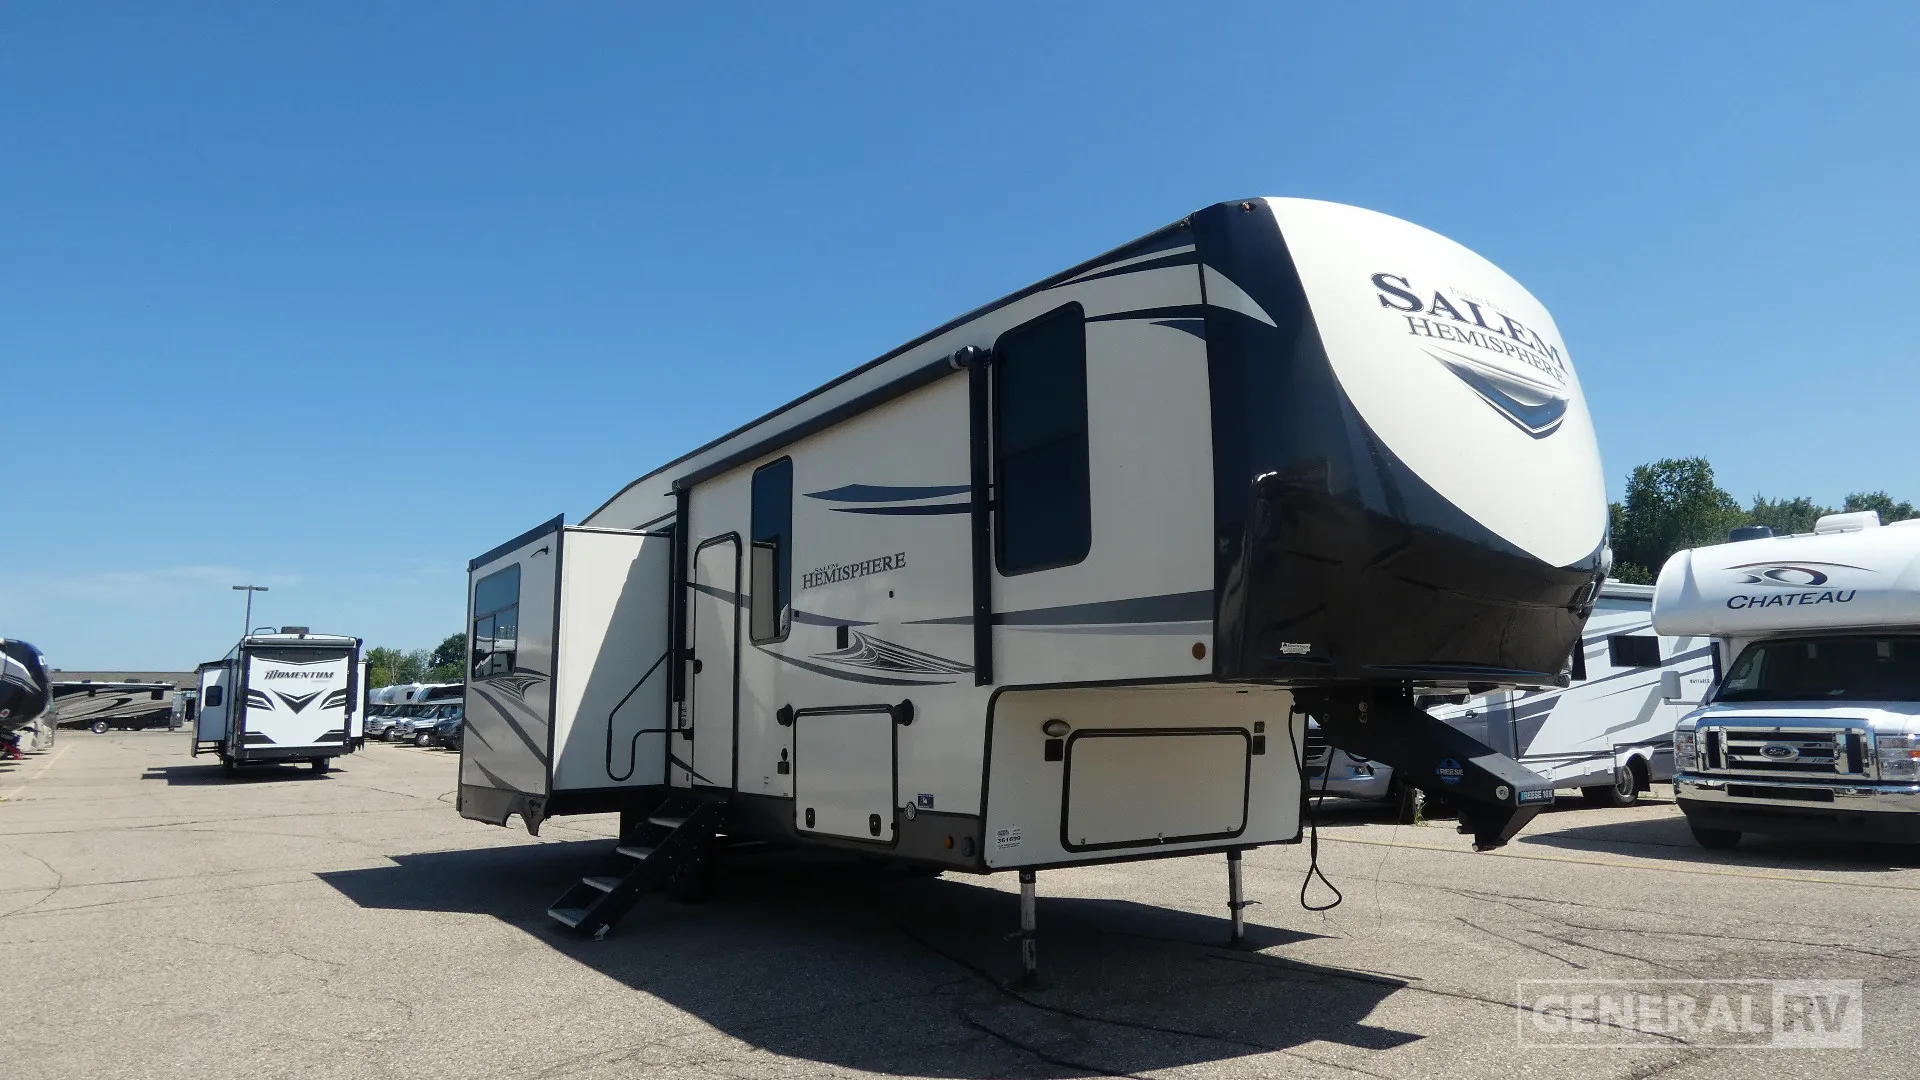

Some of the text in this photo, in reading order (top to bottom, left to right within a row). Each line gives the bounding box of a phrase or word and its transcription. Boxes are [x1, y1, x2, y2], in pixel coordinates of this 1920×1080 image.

[1370, 272, 1569, 377] SALEM
[1402, 314, 1566, 386] HEMISPHERE
[801, 552, 907, 590] HEMISPHERE
[1726, 589, 1857, 610] CHATEAU
[264, 669, 335, 680] MOMENTUM
[1440, 768, 1464, 776] REESE
[1523, 790, 1542, 800] REESE
